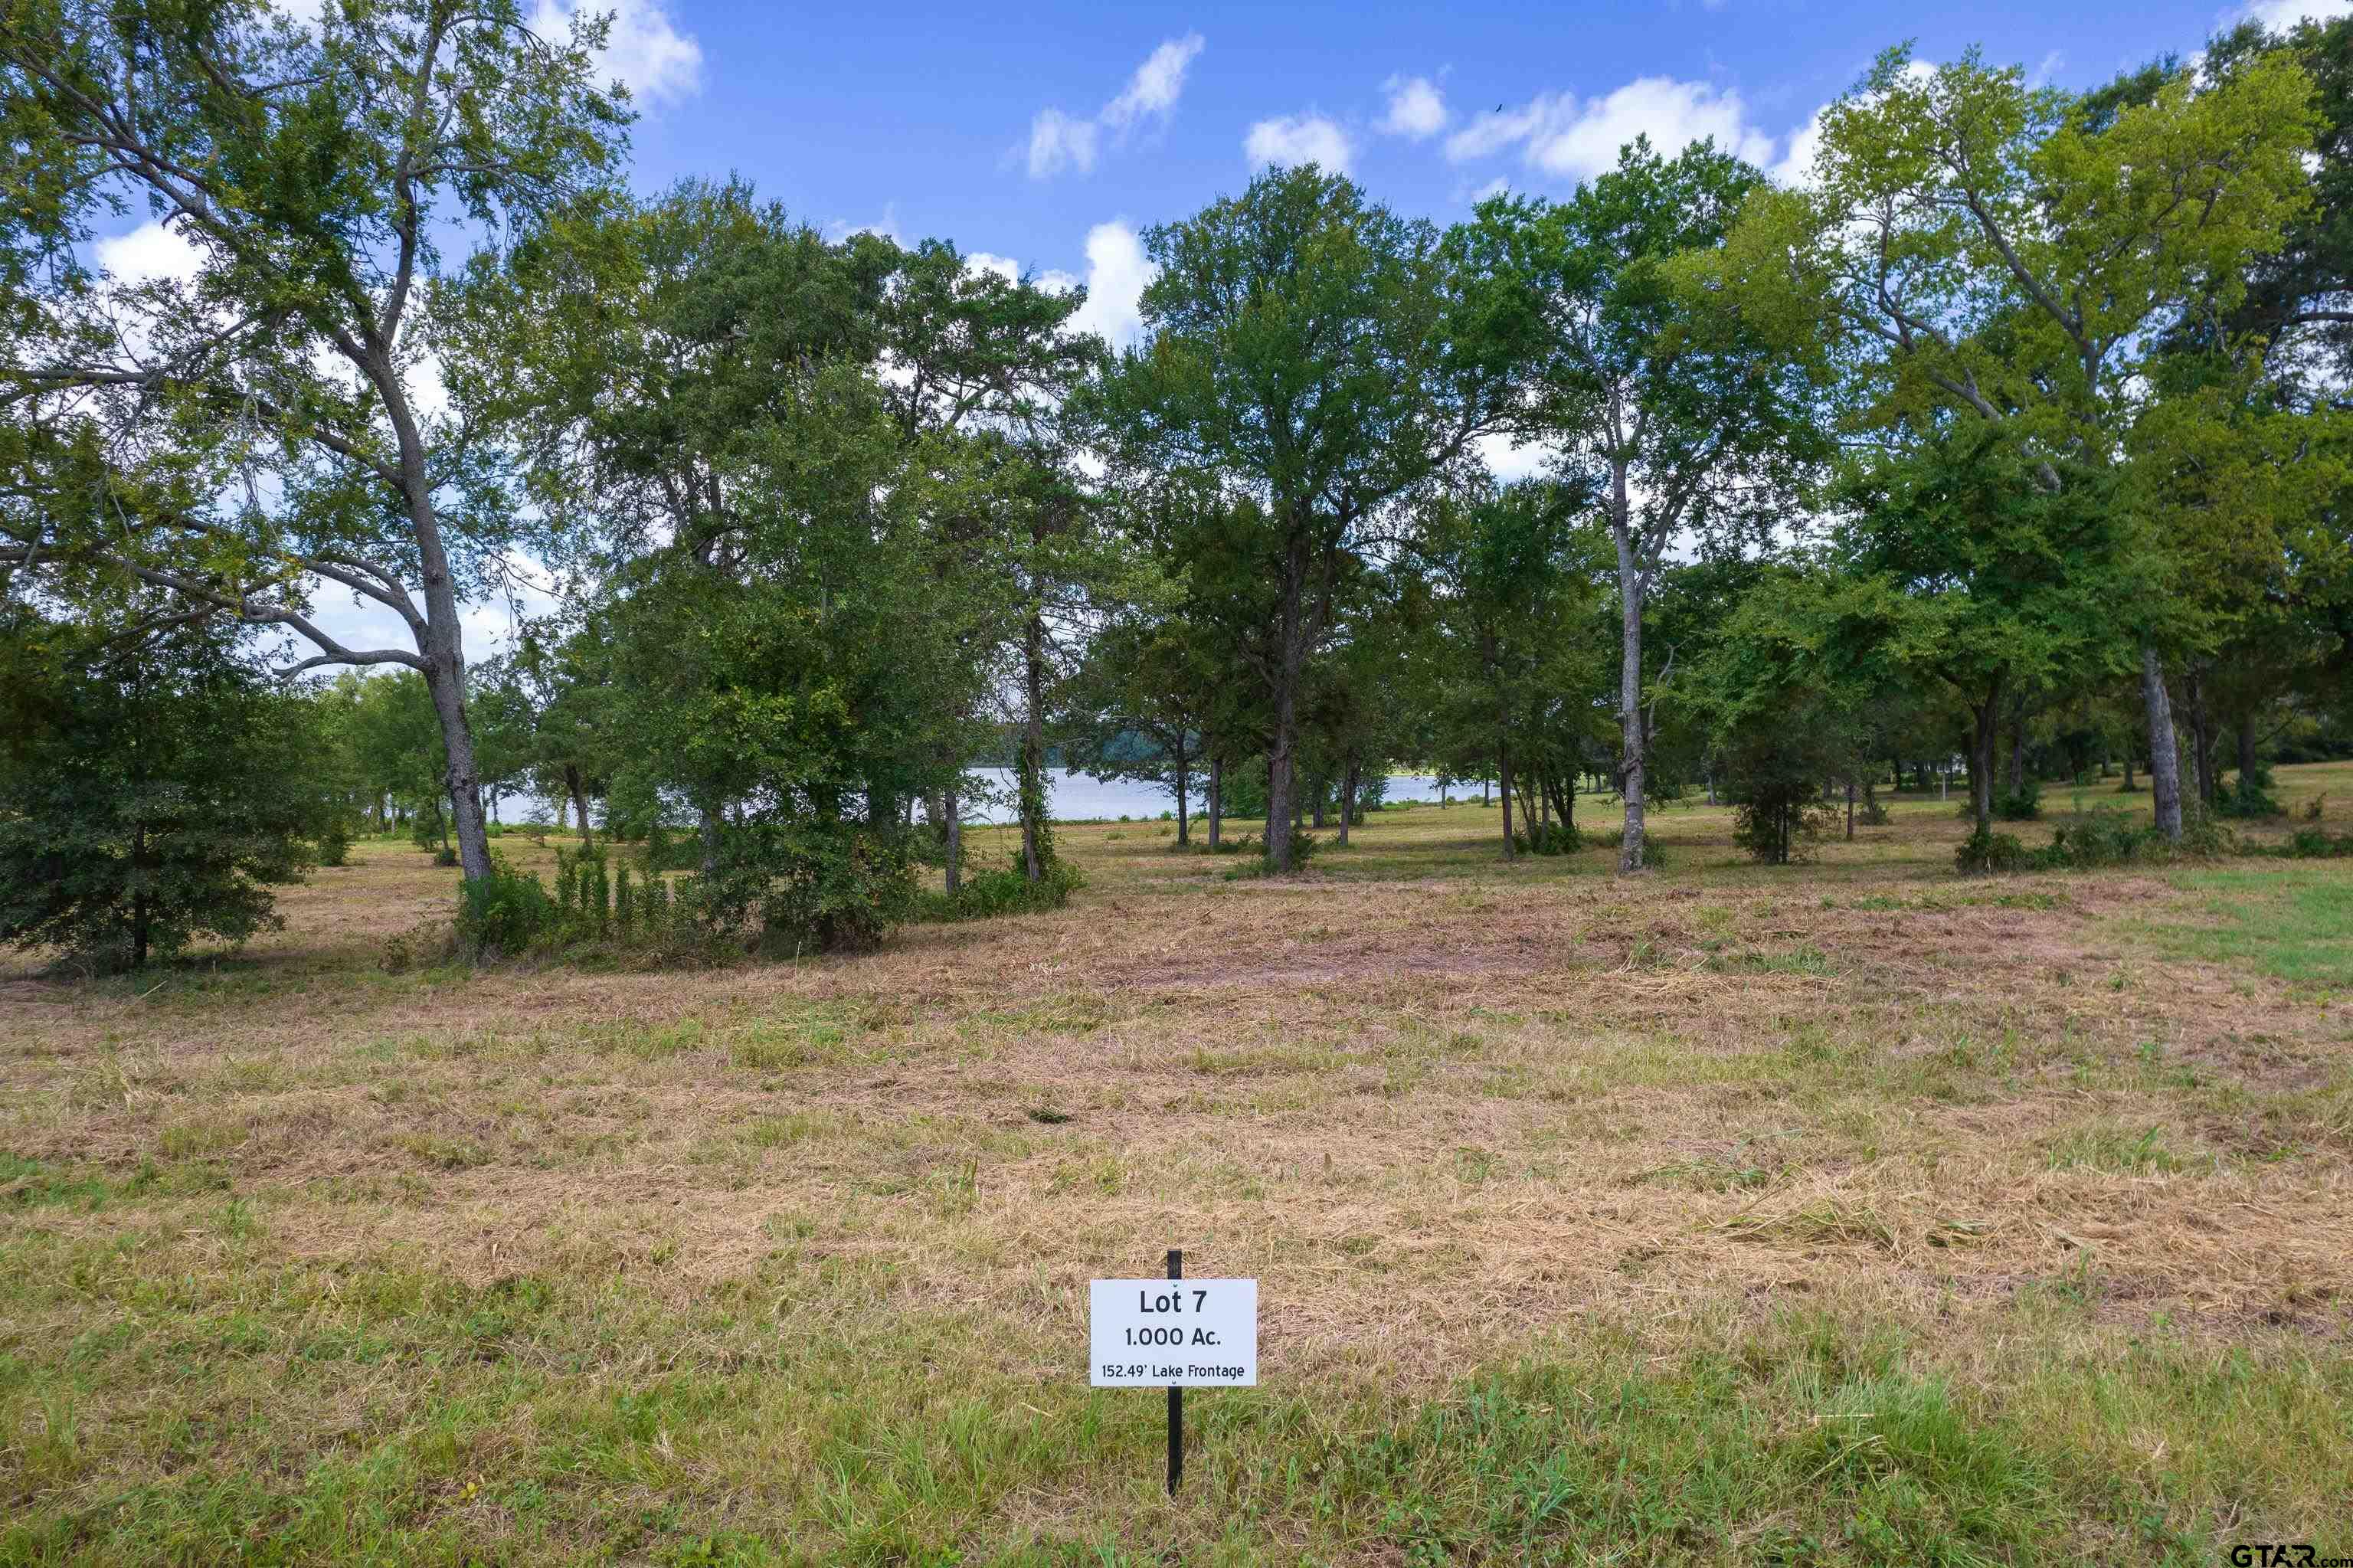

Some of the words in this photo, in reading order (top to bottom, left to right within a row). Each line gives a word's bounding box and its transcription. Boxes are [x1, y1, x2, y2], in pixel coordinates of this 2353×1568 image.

[1140, 1290, 1182, 1313] Lot
[1192, 1290, 1207, 1313] 7
[1125, 1327, 1183, 1346] 1.000
[1191, 1327, 1221, 1346] Ac.
[1101, 1364, 1148, 1377] 152.49'
[1152, 1364, 1183, 1377] Lake
[1188, 1364, 1245, 1380] Frontage
